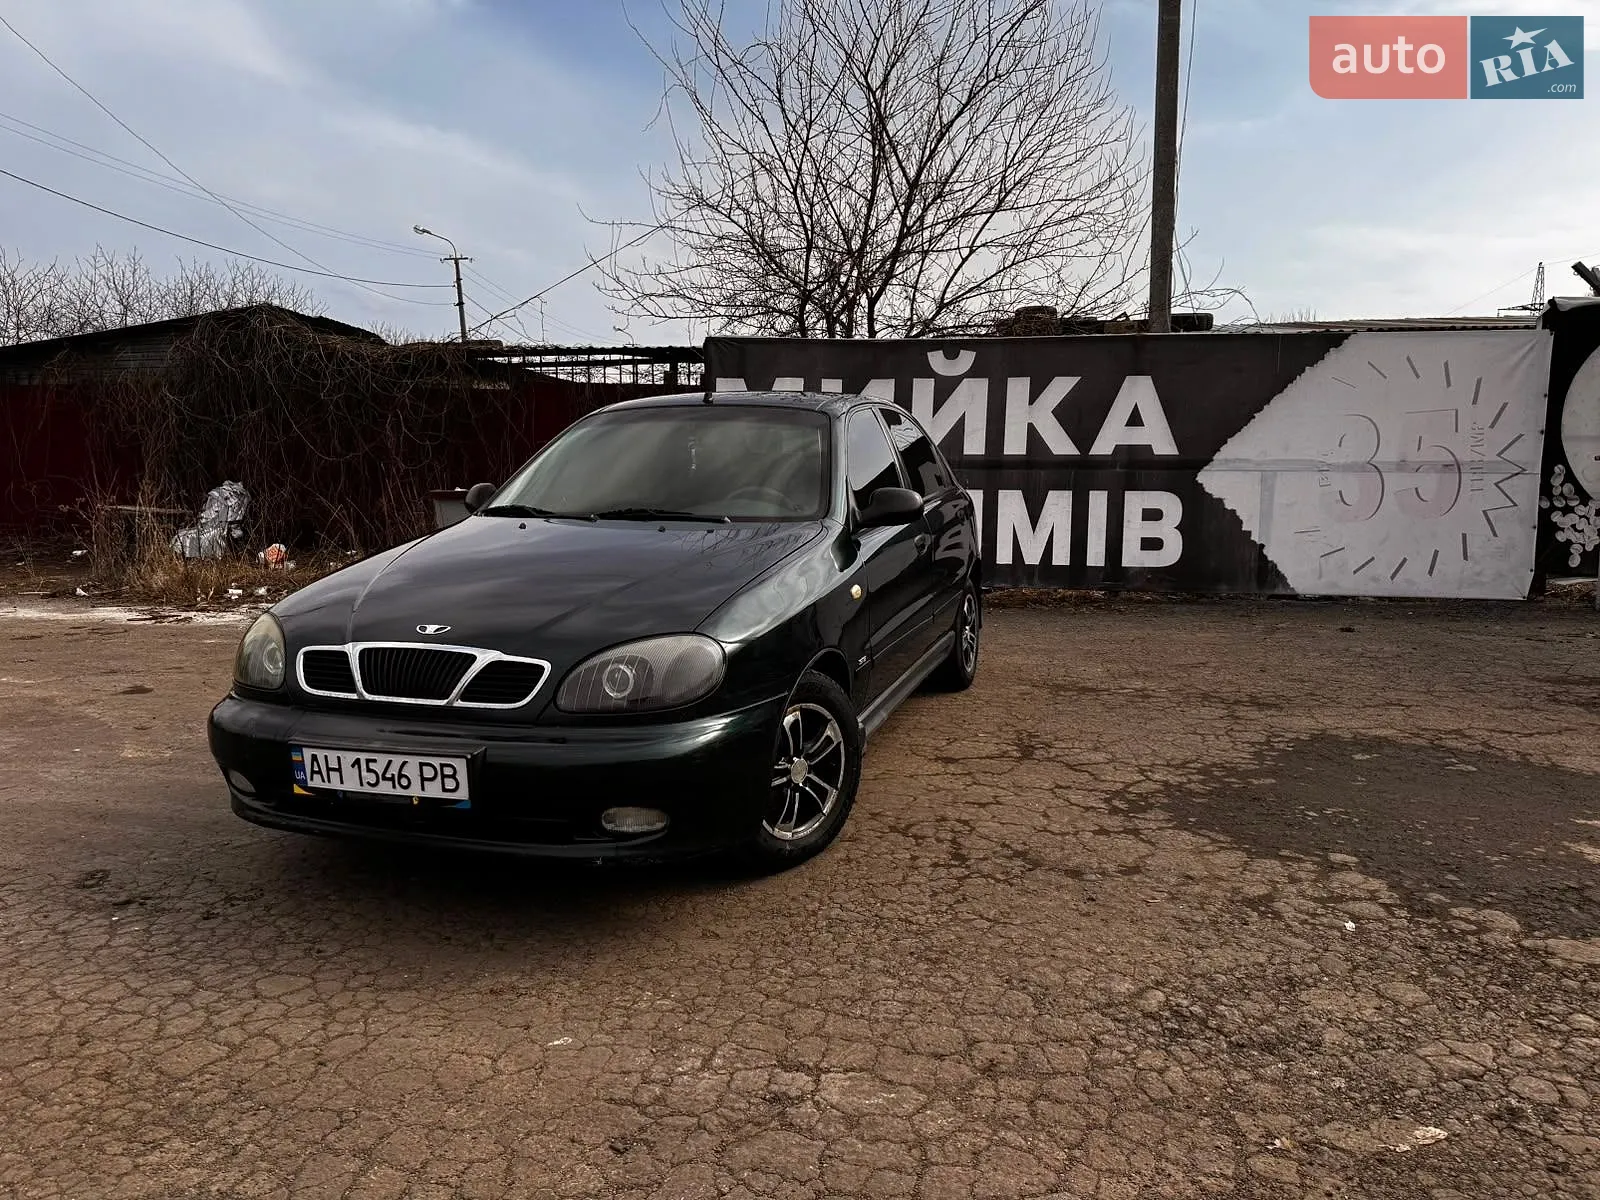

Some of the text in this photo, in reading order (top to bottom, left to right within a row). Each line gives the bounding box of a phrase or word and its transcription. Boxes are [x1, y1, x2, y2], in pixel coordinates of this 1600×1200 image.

[716, 350, 1180, 456] ЙКА
[973, 489, 1183, 568] МІВ
[294, 769, 306, 781] UA
[309, 753, 461, 793] AH 1546 PB
